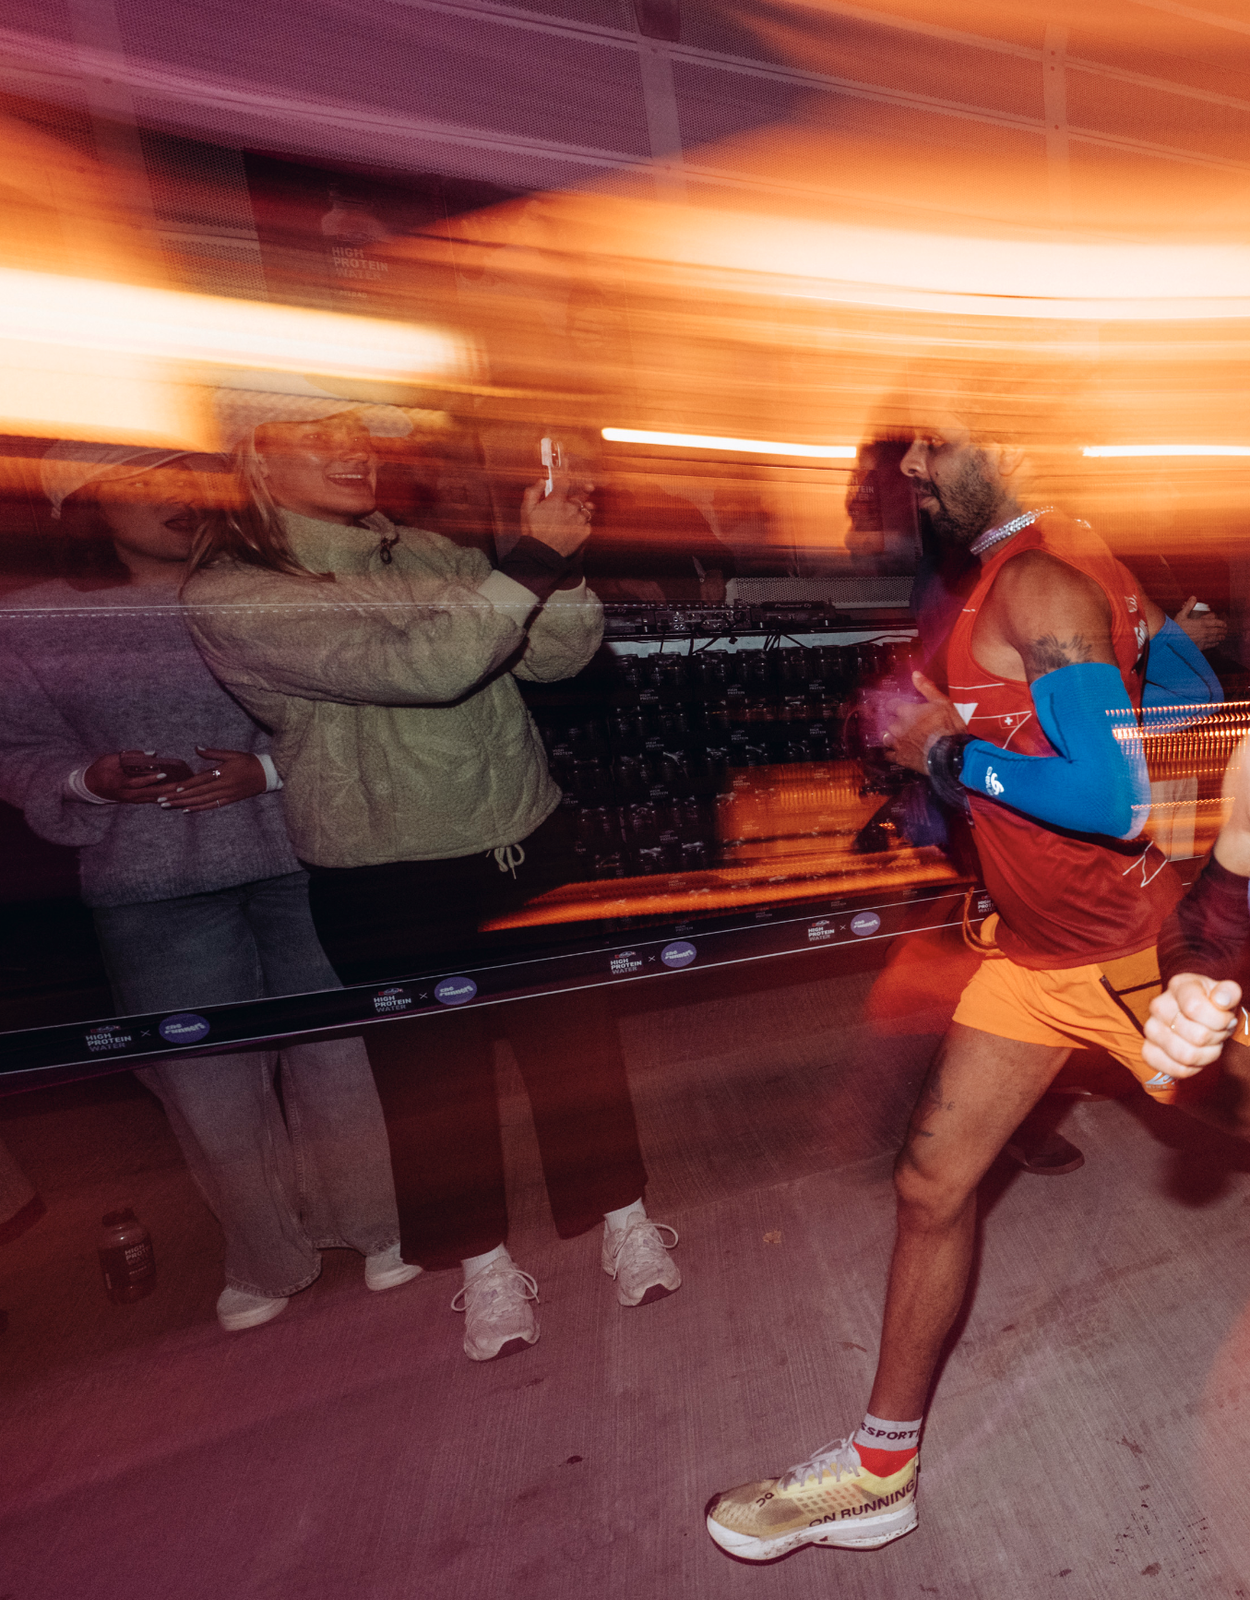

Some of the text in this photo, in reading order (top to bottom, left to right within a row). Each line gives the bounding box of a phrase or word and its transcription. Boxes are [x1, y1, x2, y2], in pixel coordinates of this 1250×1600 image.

[332, 247, 364, 258] HIGH
[333, 256, 388, 271] PROTEIN
[611, 960, 642, 970] PROTEIN
[612, 966, 638, 975] WATER
[373, 995, 395, 1003] HIGH
[374, 998, 412, 1008] PROTEIN
[376, 1004, 406, 1013] WATER
[85, 1032, 112, 1041] HIGH
[87, 1035, 132, 1047] PROTEIN
[89, 1042, 126, 1052] WATER
[809, 1478, 915, 1527] ON RUNNING
